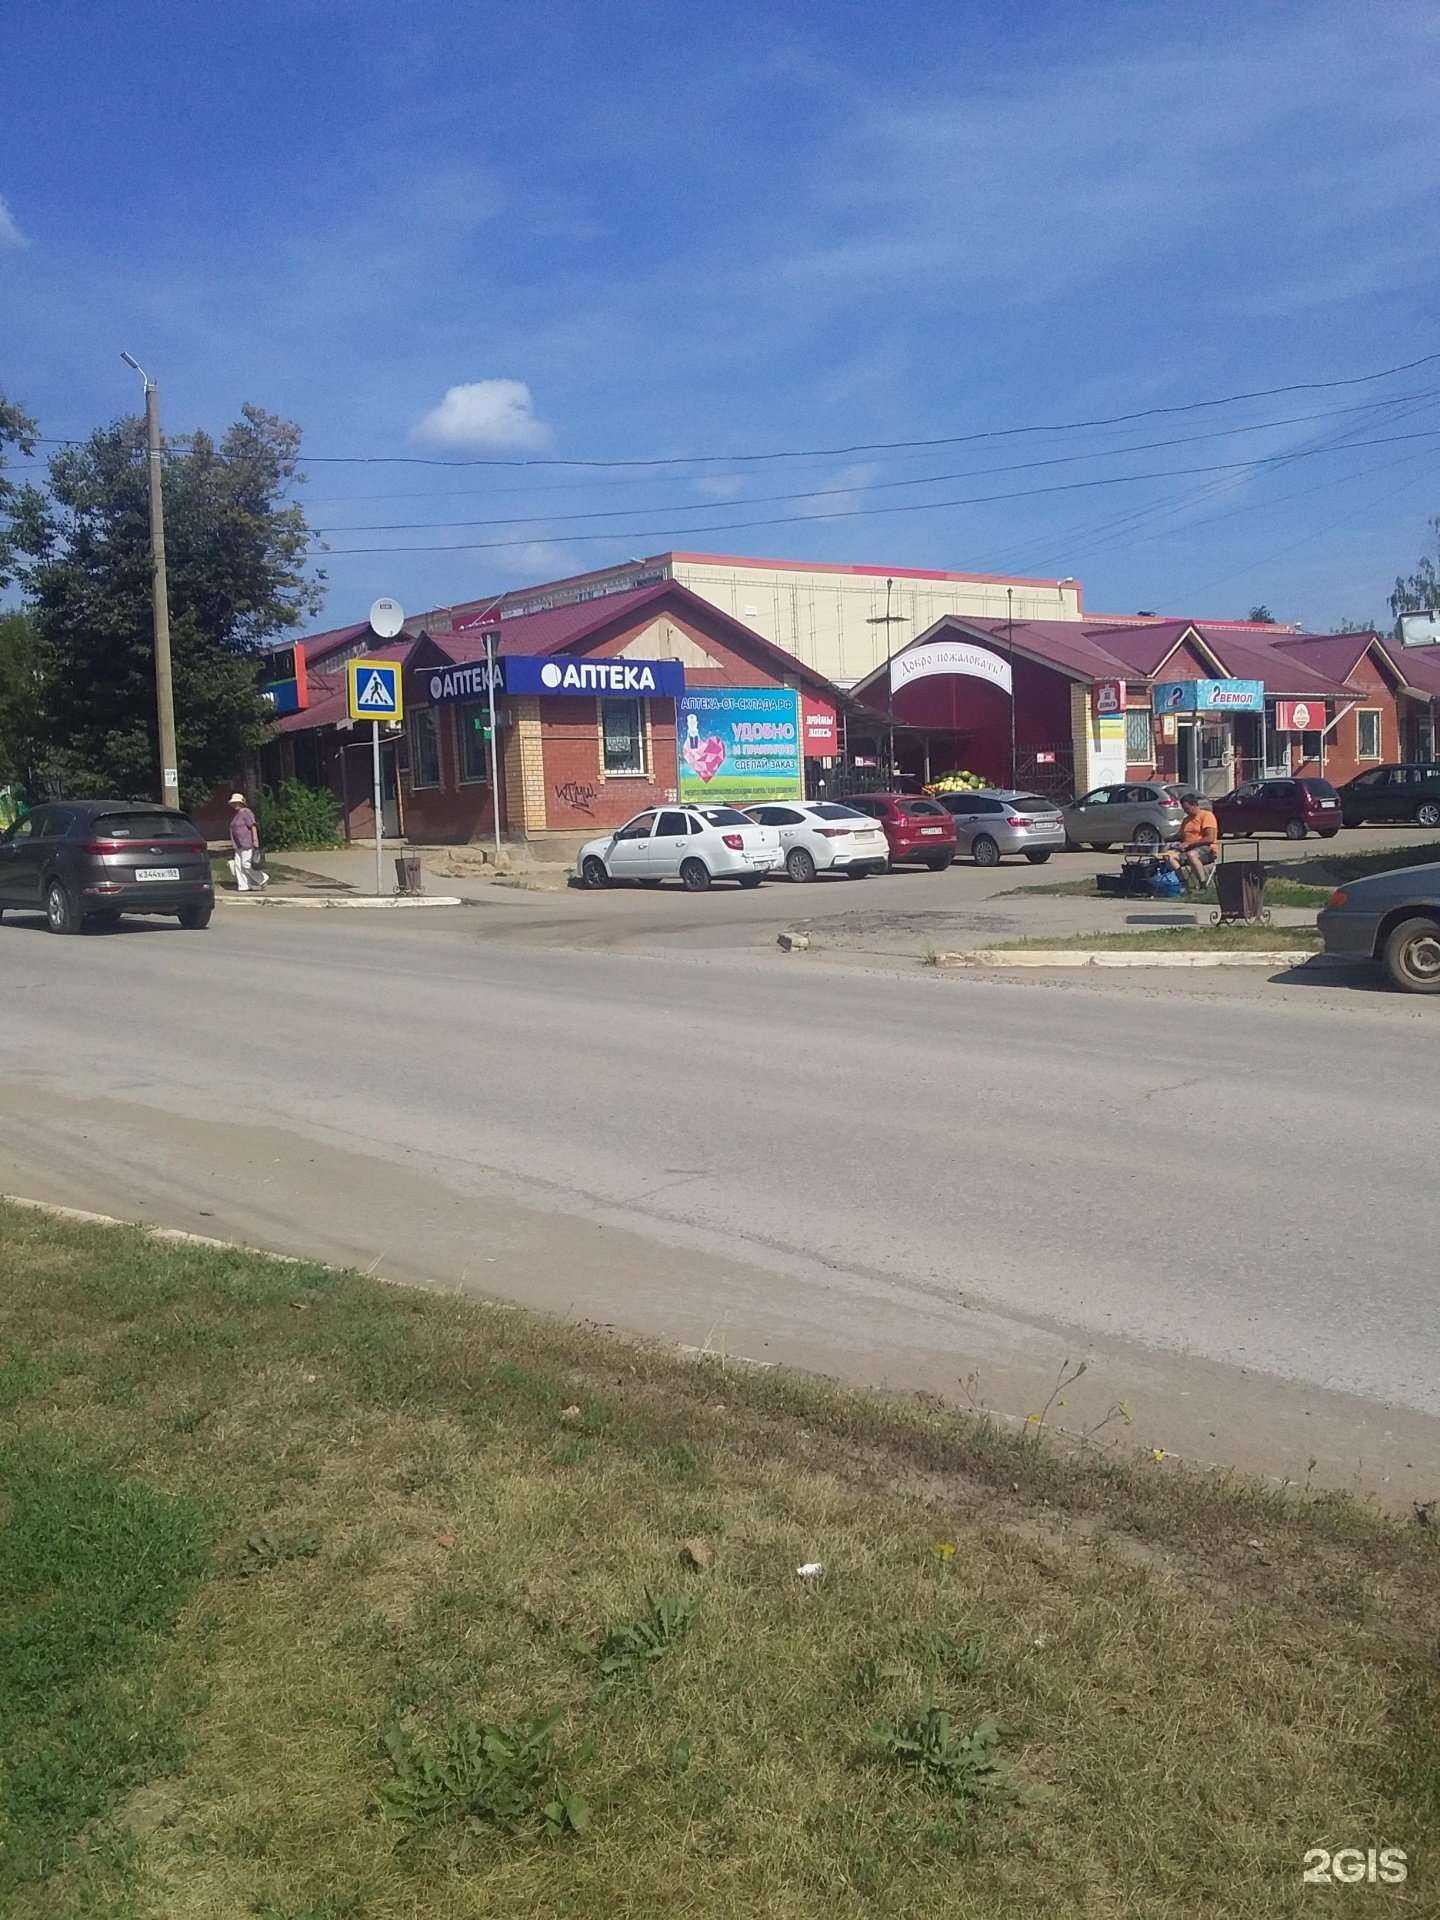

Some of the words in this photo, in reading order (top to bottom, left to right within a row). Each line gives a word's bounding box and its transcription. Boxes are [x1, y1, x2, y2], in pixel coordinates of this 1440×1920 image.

[901, 655, 932, 677] Добро
[442, 664, 504, 698] АПТЕКА
[563, 664, 656, 691] АПТЕКА
[731, 722, 795, 742] УДОБНО
[734, 757, 768, 771] СДЕЛАЙ
[770, 759, 796, 770] ЗАКАЗ
